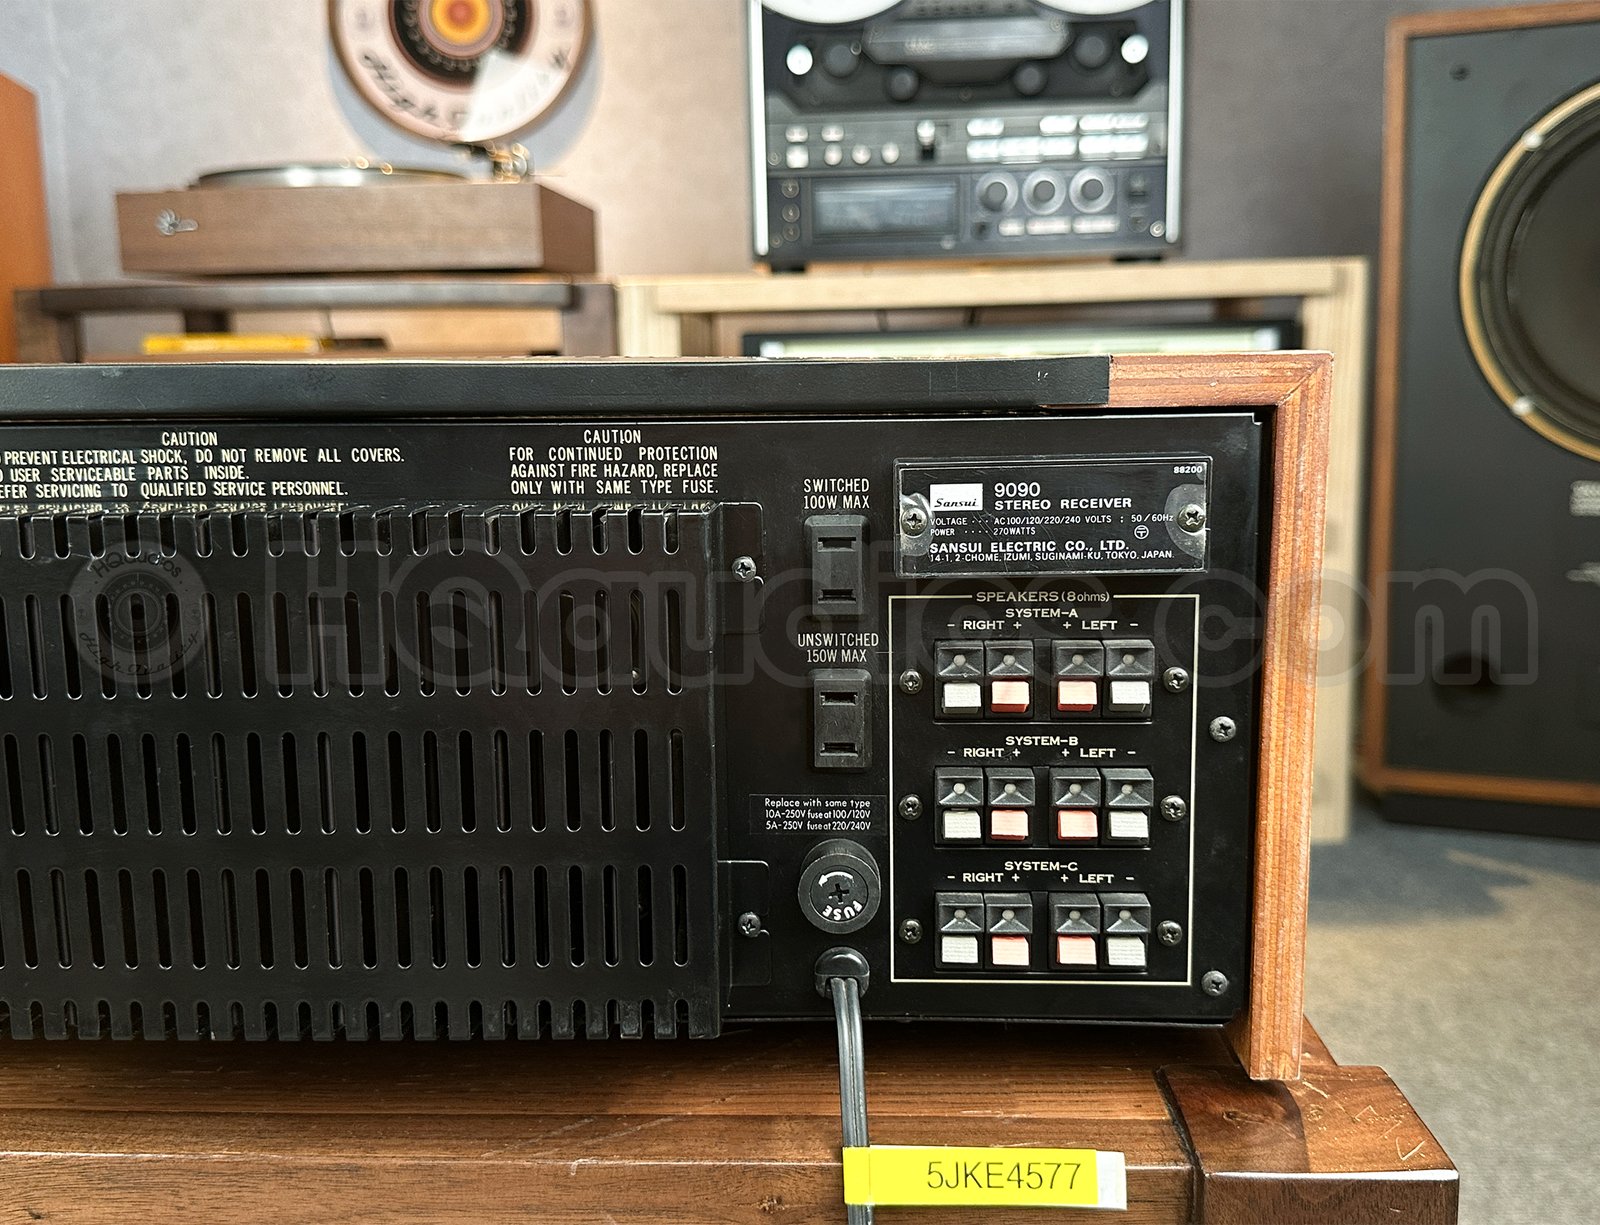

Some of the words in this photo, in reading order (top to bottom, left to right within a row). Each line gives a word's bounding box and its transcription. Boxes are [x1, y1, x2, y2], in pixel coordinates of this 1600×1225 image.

[162, 432, 217, 446] CAUTION
[584, 430, 641, 444] CAUTION
[4, 451, 57, 465] PREVENT
[62, 450, 137, 464] ELECTRICAL
[141, 449, 187, 464] SHOCK,
[195, 449, 212, 463] DO
[221, 449, 246, 463] NOT
[255, 448, 308, 462] REMOVE
[318, 449, 341, 462] ALL
[352, 448, 404, 462] COVERS.
[510, 447, 533, 461] FOR
[549, 447, 622, 461] CONTINUED
[639, 446, 717, 460] PROTECTION
[10, 468, 40, 482] USER
[51, 467, 136, 482] SERVICEABLE
[147, 465, 188, 480] PARTS
[205, 465, 249, 479] INSIDE.
[511, 464, 564, 477] AGAINST
[571, 464, 597, 477] FIRE
[604, 464, 657, 479] HAZARD,
[664, 463, 718, 477] REPLACE
[36, 484, 101, 498] SERVICING
[111, 483, 127, 497] TO
[141, 482, 206, 499] QUALIFIED
[213, 482, 266, 496] SERVICE
[272, 481, 348, 495] PERSONNEL.
[511, 481, 542, 494] ONLY
[551, 481, 584, 494] WITH
[597, 480, 631, 494] SAME
[641, 480, 672, 493] TYPE
[683, 480, 718, 493] FUSE.
[804, 478, 869, 492] SWITCHED
[995, 482, 1040, 497] 9090
[804, 495, 837, 509] 100W
[843, 495, 869, 508] MAX
[934, 499, 976, 507] Sansui
[995, 500, 1051, 510] STEREO
[1061, 498, 1131, 509] RECEIVER
[930, 517, 968, 526] VOLTAGE
[1085, 515, 1111, 523] VOLTS
[930, 528, 955, 537] POWER
[994, 527, 1035, 535] 270WATTS
[929, 541, 982, 553] SANSUI
[991, 541, 1056, 553] ELECTRIC
[1065, 541, 1093, 551] CO.,
[1100, 540, 1129, 550] LTD.
[977, 592, 1058, 601] SPEAKERS
[1006, 609, 1078, 617] SYSTEM-A
[964, 621, 1004, 629] RIGHT
[1082, 621, 1117, 630] LEFT
[798, 633, 878, 647] UNSWITCHED
[807, 649, 837, 662] 150W
[842, 649, 866, 662] MAX
[1006, 736, 1078, 745] SYSTEM-B
[964, 748, 1004, 757] RIGHT
[1080, 748, 1116, 757] LEFT
[765, 798, 800, 808] Replace
[803, 798, 821, 806] with
[850, 800, 870, 808] type
[766, 809, 805, 818] 10A-250V
[833, 810, 870, 818] 100/120V
[832, 821, 870, 830] 220/240V
[1005, 861, 1078, 871] SYSTEM-C
[963, 873, 1003, 882] RIGHT
[1080, 874, 1114, 883] LEFT
[822, 901, 863, 921] FUSE
[928, 1162, 1080, 1189] 5JKE4577
